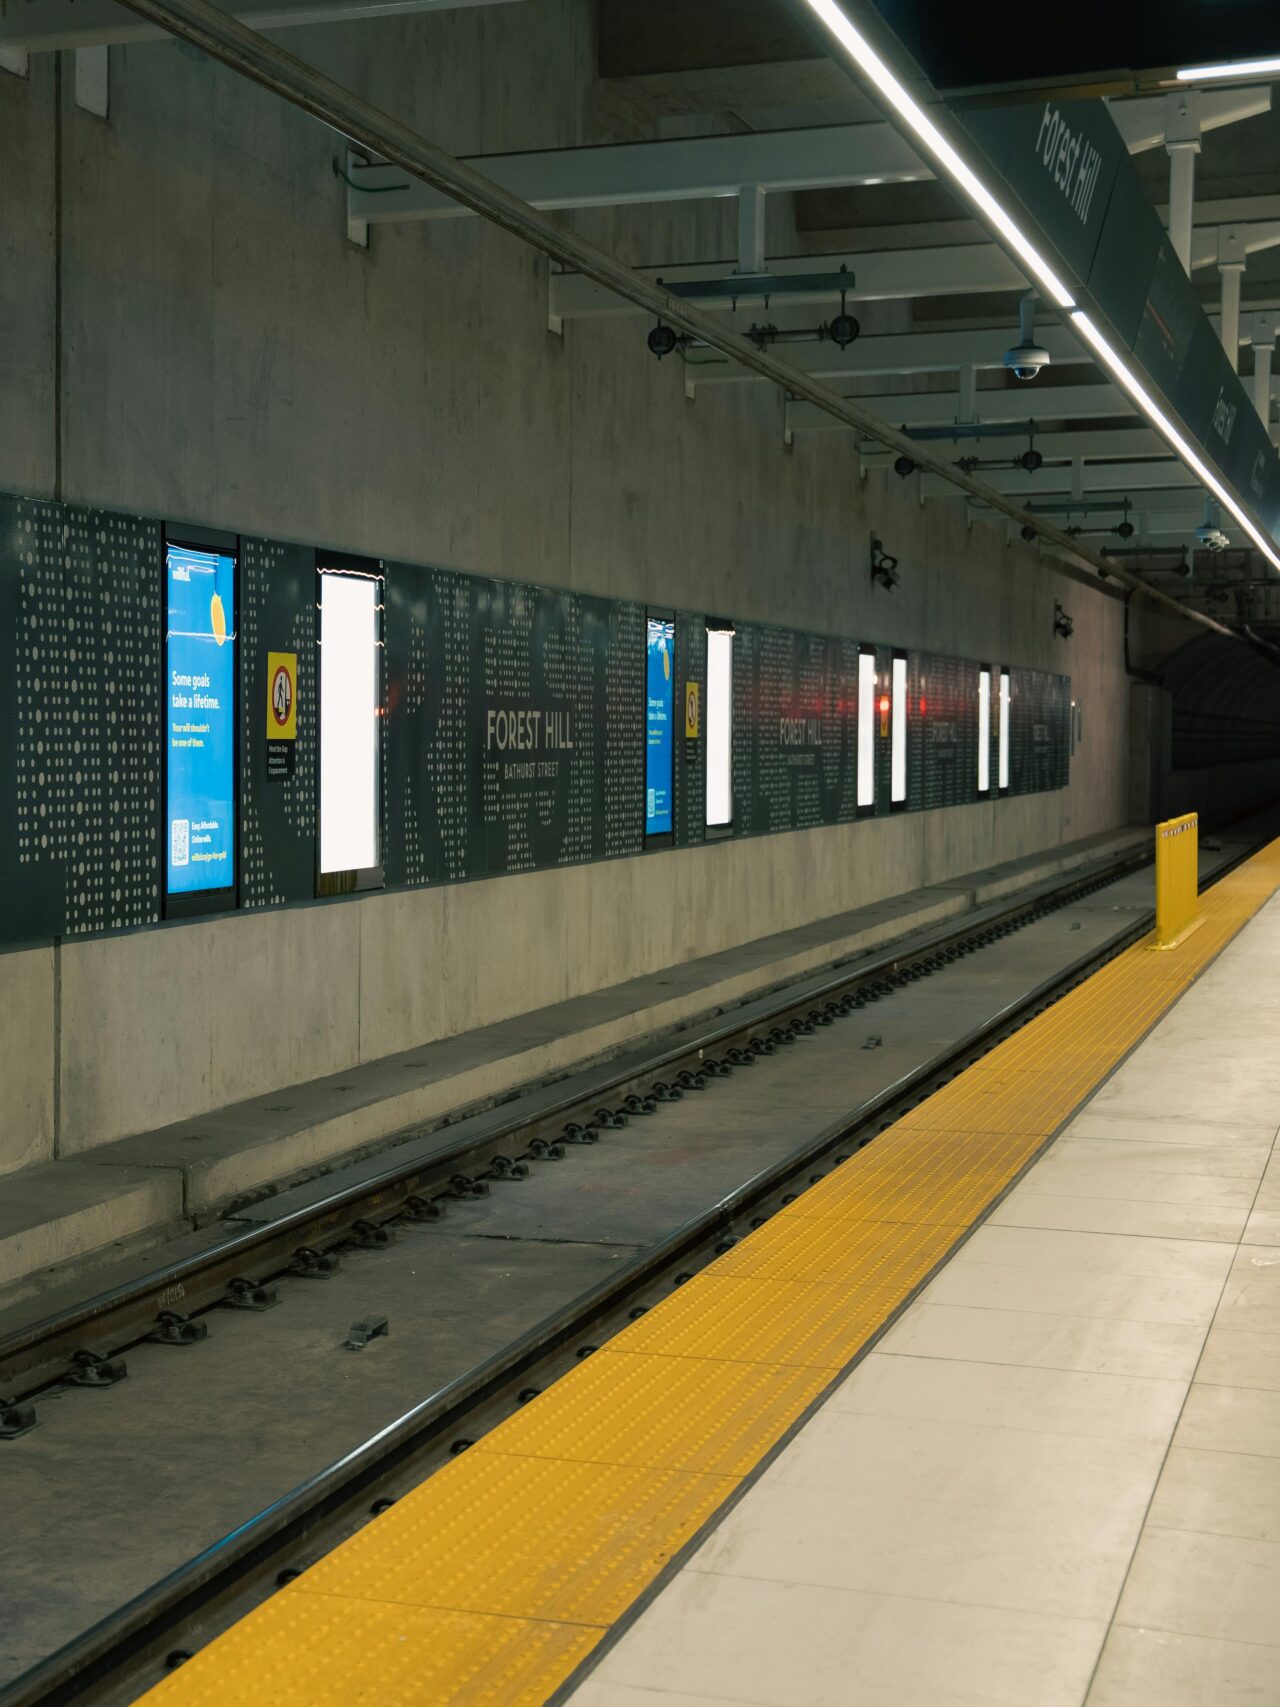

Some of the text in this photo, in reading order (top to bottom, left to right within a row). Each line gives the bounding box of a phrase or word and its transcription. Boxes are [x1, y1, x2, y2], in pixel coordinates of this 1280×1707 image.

[1071, 140, 1101, 225] Hill
[172, 670, 210, 691] Some goals
[172, 693, 187, 708] take
[487, 710, 573, 751] FOREST HILL
[504, 761, 559, 780] BATHURST STREET
